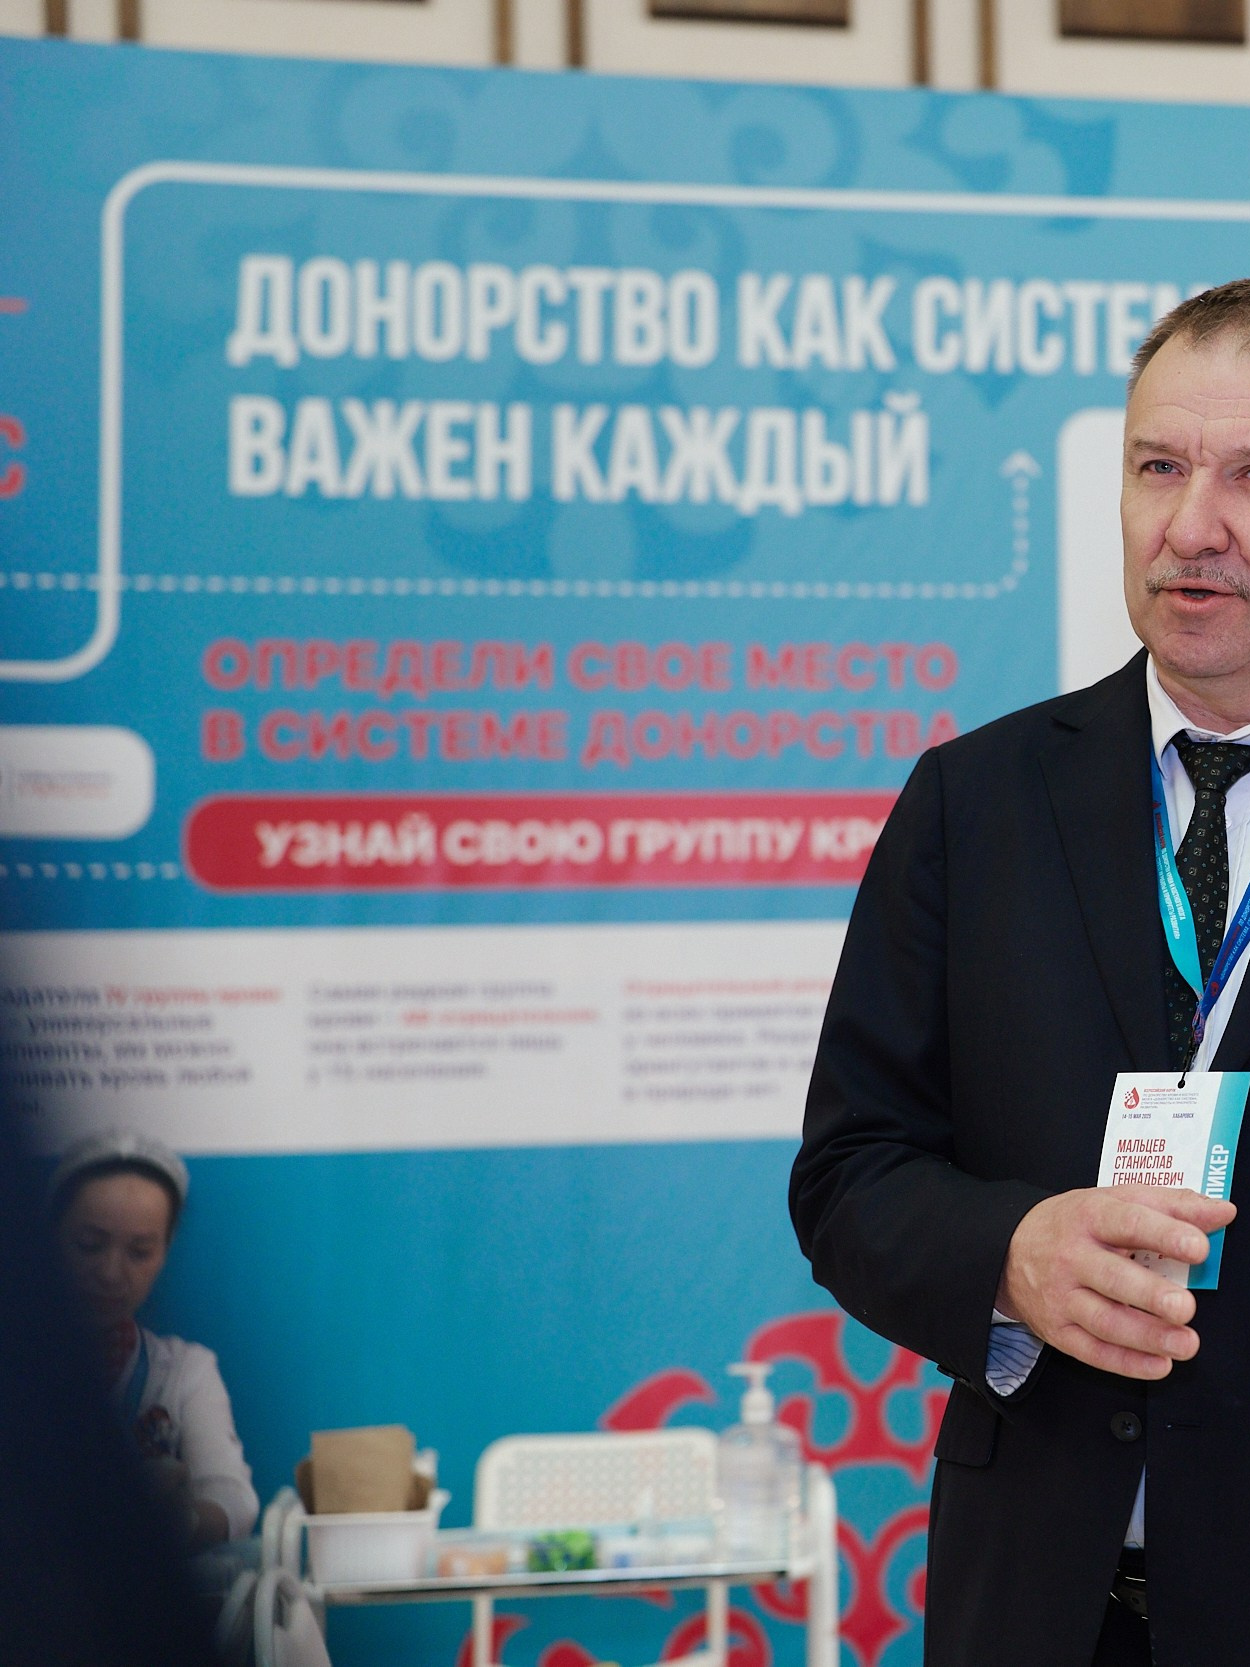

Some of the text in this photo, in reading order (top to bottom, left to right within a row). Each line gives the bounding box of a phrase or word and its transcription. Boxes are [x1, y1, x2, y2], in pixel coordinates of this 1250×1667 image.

[227, 253, 1210, 377] ДОНОРСТВО КАК СИСТЕ
[228, 392, 928, 517] ВАЖЕН КАЖДЫЙ
[203, 639, 957, 699] ОПРЕДЕЛИ СВОЕ МЕСТО
[203, 709, 958, 770] В СИСТЕМЕ ДОНОРСТВА
[255, 811, 435, 867] УЗНАЙ
[441, 819, 605, 864] СВОЮ
[607, 817, 806, 863] ГРУППУ
[1114, 1155, 1173, 1169] СТАНИСЛАВ
[1117, 1139, 1166, 1154] МАЛЬЦЕВ
[1205, 1144, 1230, 1199] ПИКЕР
[1112, 1171, 1184, 1186] ГЕННАДЬЕВИЧ
